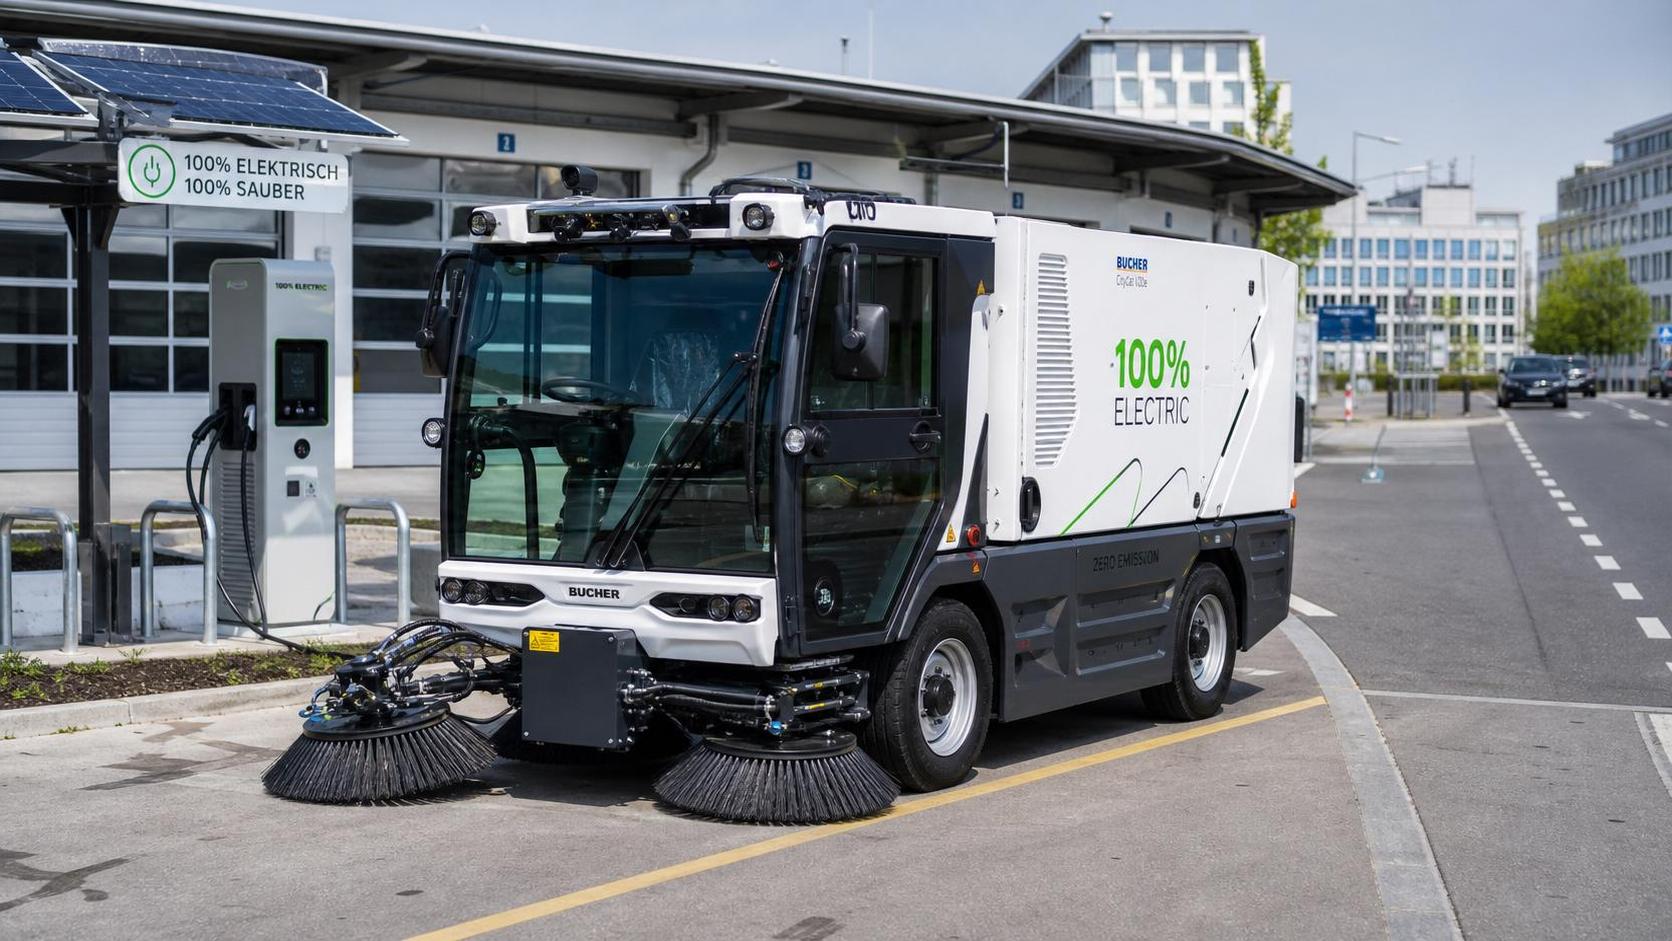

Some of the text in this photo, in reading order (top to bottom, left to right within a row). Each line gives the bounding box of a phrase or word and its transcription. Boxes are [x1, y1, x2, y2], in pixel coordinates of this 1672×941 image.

[185, 154, 339, 181] 100% ELEKTRISCH
[185, 178, 305, 200] 100% SAUBER
[1116, 255, 1149, 271] BUCHER
[295, 283, 328, 292] ELECTRIC
[1115, 338, 1190, 389] 100%
[1115, 396, 1190, 426] ELECTRIC
[1117, 547, 1160, 569] EMISSION
[568, 586, 620, 600] BUCHER
